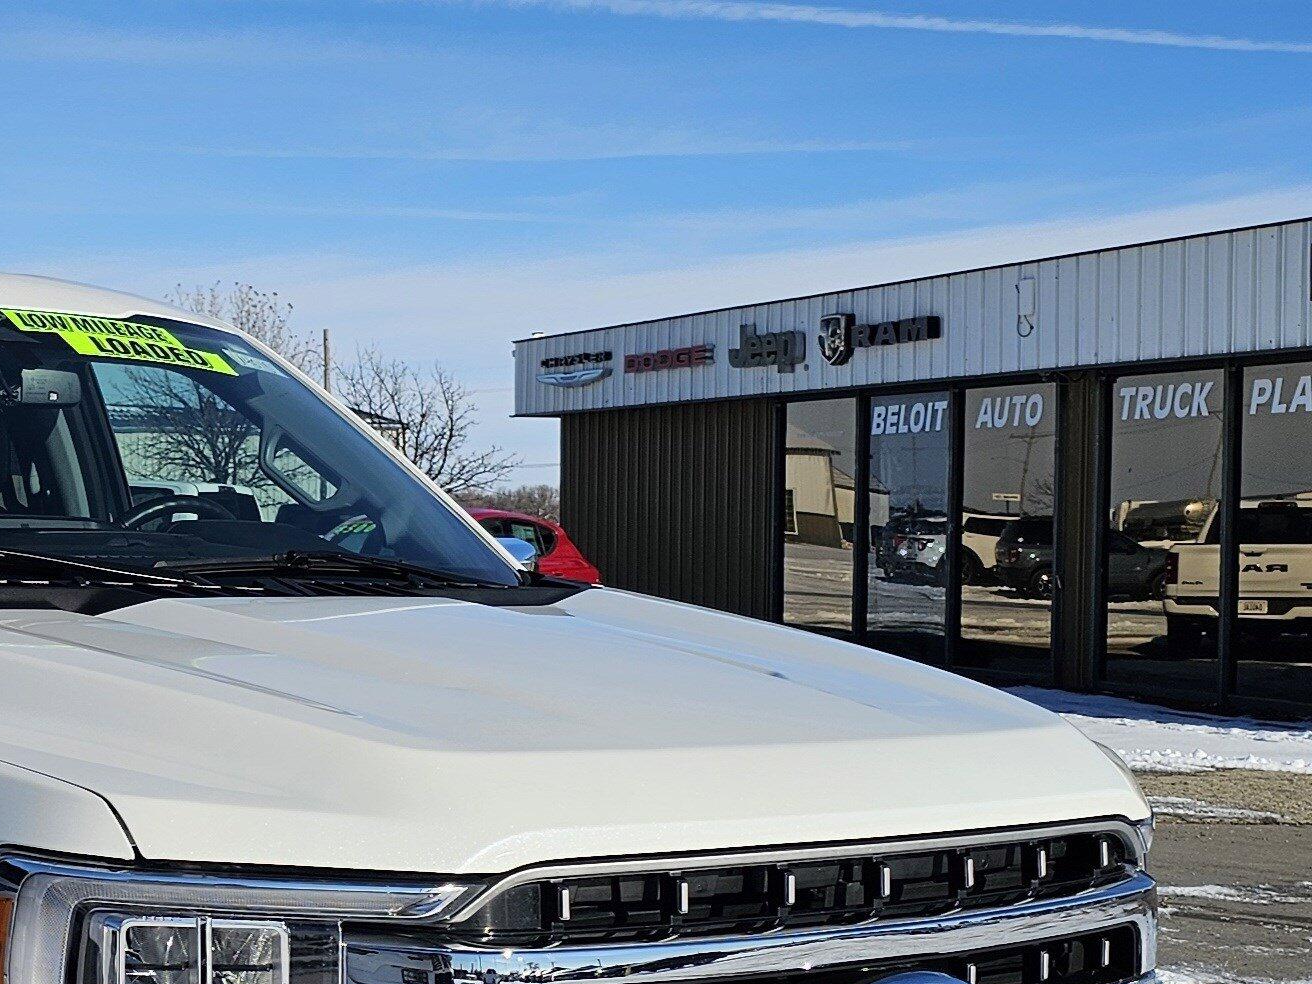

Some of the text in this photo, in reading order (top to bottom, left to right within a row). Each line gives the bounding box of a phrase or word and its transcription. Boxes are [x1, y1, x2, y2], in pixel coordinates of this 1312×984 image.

[15, 311, 172, 342] LOW MILEAGE
[851, 315, 941, 347] RAM
[90, 336, 214, 369] LOADED
[624, 344, 715, 373] DODGE
[728, 324, 807, 373] Jeep
[871, 375, 1312, 436] BELOIT AUTO TRUCK PLA
